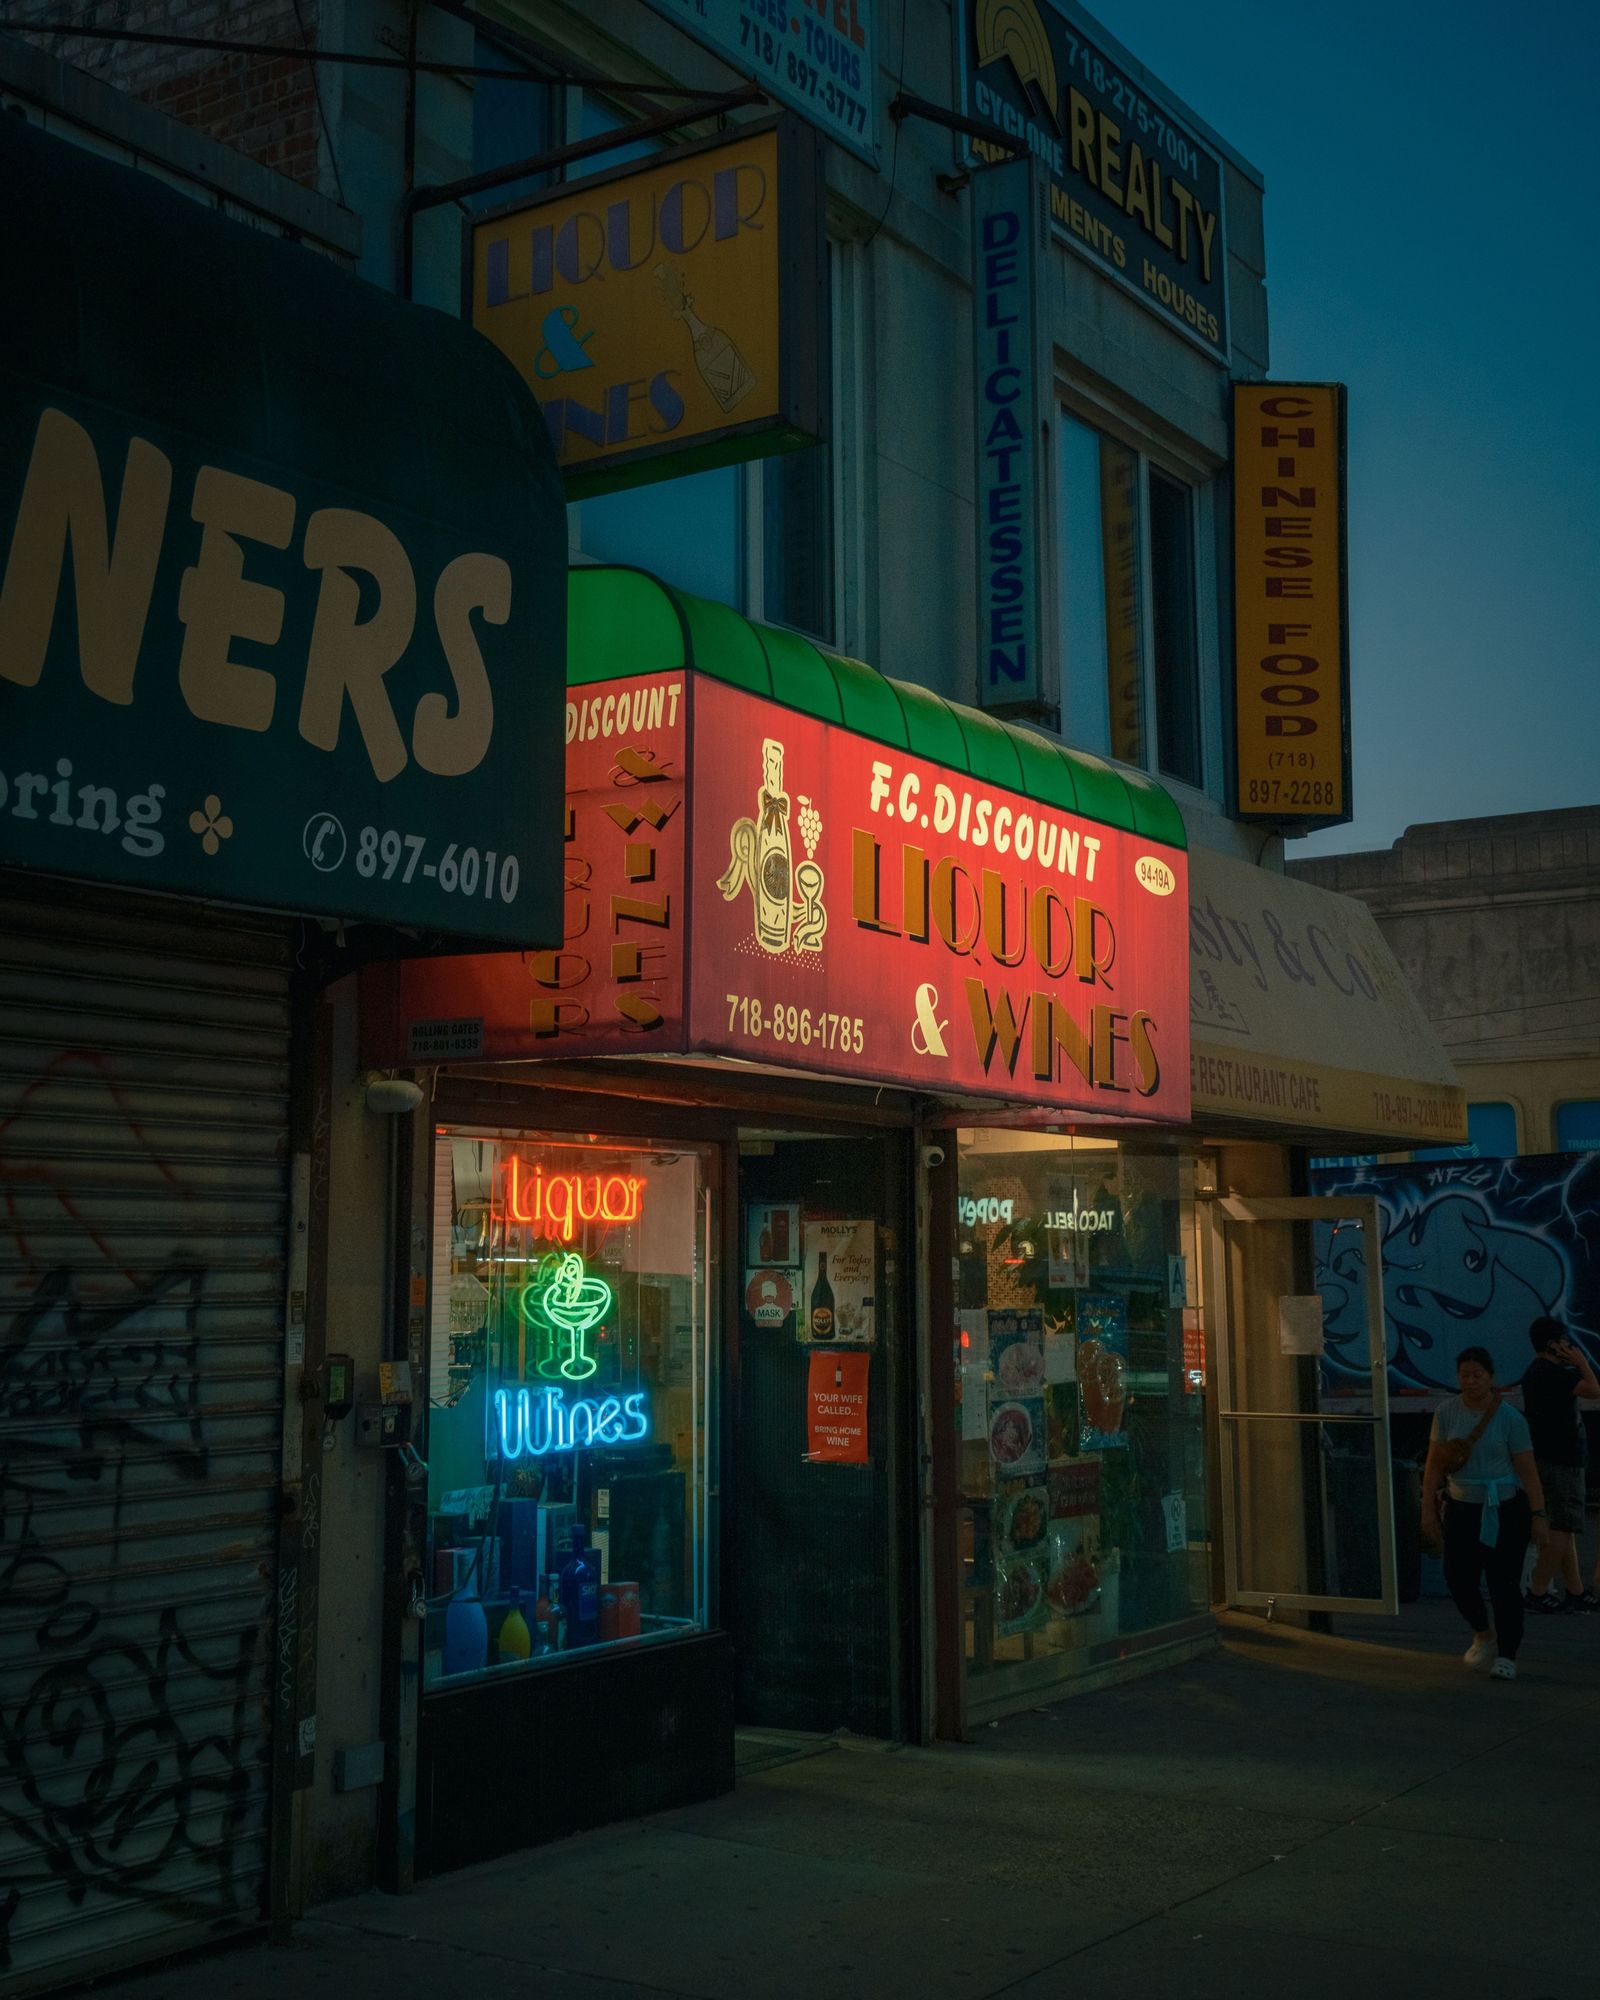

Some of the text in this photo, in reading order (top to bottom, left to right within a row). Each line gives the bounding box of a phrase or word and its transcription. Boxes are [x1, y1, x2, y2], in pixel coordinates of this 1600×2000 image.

[804, 15, 861, 91] TOURS
[787, 51, 867, 134] 897-3777
[1065, 30, 1198, 181] 718-275-7001
[1069, 84, 1217, 283] REALTY
[485, 164, 766, 307] LIQUOR
[1143, 257, 1219, 343] HOUSES
[534, 305, 593, 379] &
[983, 211, 1027, 686] DELICATESSEN
[1259, 397, 1320, 738] CHINESE FOOD
[565, 684, 682, 744] DISCOUNT
[1248, 780, 1334, 807] 897-2288
[1267, 751, 1315, 769] (718)
[355, 825, 520, 903] 897-6010
[1140, 867, 1171, 893] 94-19A
[851, 827, 1117, 991] LIQUOR
[412, 1023, 480, 1037] ROLLING GATES
[726, 993, 865, 1056] 718-896-1785
[910, 982, 950, 1058] &
[963, 976, 1160, 1098] WINES
[1200, 1056, 1286, 1107] RESTAURANT
[1289, 1074, 1321, 1113] CAFE
[510, 1155, 644, 1241] Liquor
[832, 1255, 845, 1265] For
[1172, 1262, 1184, 1294] A
[757, 1309, 780, 1318] MASK
[494, 1386, 649, 1459] Wines
[814, 1393, 863, 1404] YOUR WIFE
[814, 1425, 862, 1435] BRING HOME
[817, 1405, 859, 1416] CALLED...
[826, 1436, 849, 1446] WINE
